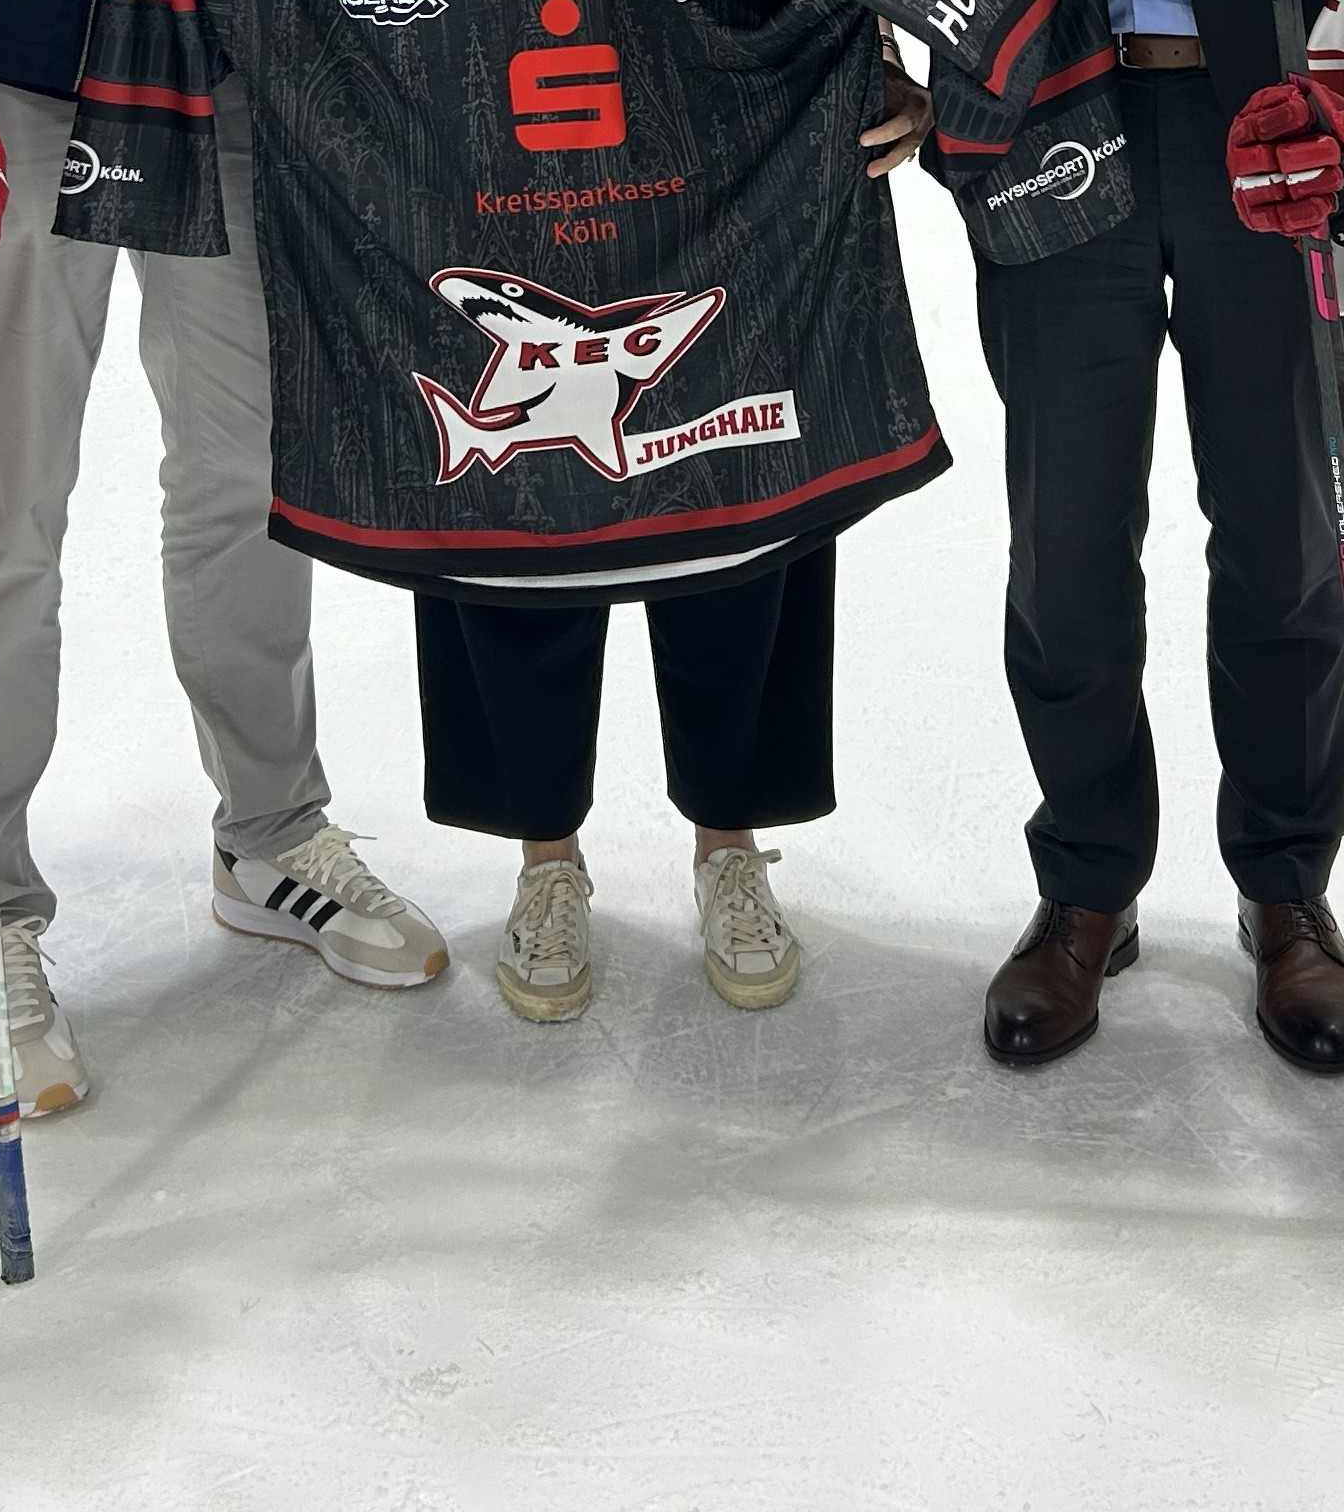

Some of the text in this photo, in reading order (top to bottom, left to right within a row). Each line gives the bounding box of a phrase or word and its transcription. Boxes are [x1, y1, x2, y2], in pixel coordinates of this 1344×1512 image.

[475, 174, 687, 215] Kreissparkasse
[987, 155, 1085, 210] PHYSIOSPORT
[553, 218, 618, 245] Köln
[518, 326, 664, 370] KEC
[636, 401, 785, 466] JUNGHAIE
